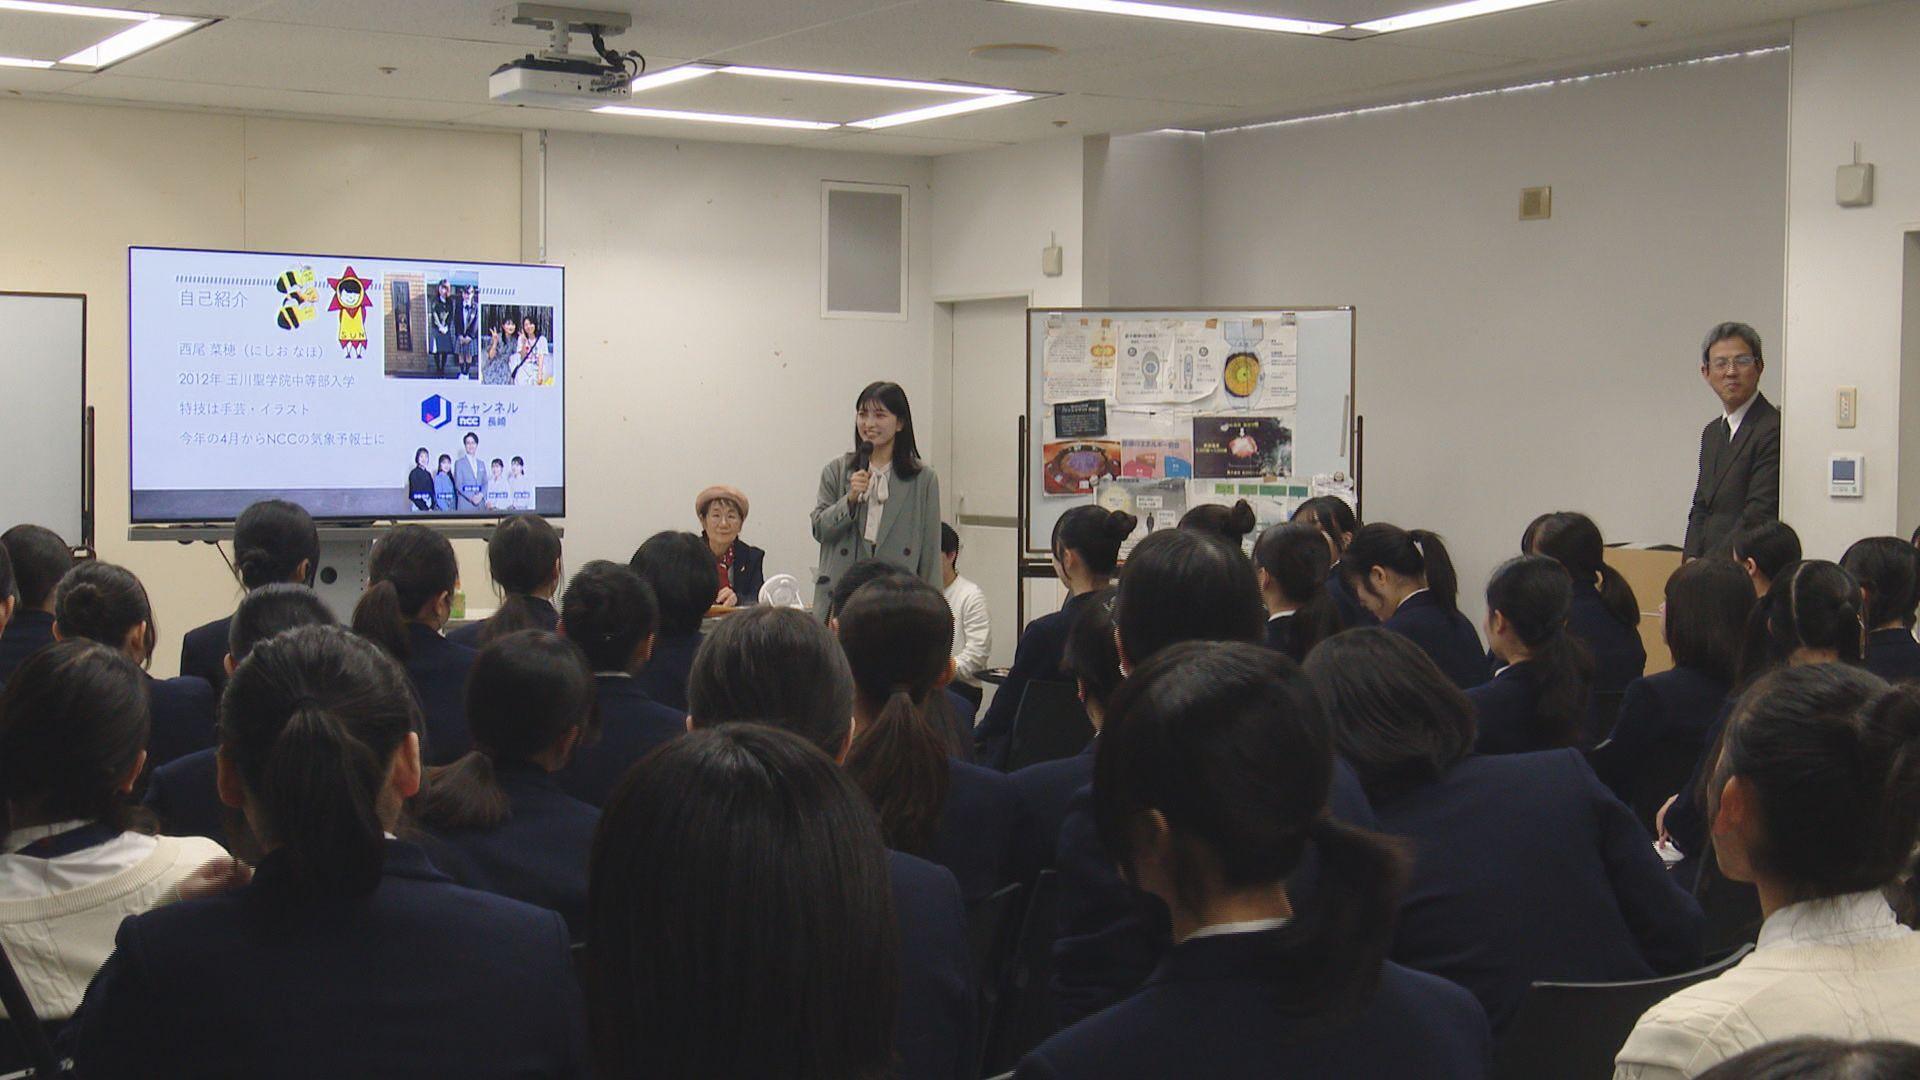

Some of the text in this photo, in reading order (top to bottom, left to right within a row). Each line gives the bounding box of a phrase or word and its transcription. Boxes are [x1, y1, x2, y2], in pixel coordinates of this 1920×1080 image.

[180, 289, 248, 309] 自己紹介
[341, 331, 365, 339] SUN
[179, 343, 206, 357] 西尾
[179, 372, 355, 388] 2012年 玉川聖学院中等部入学
[179, 402, 309, 416] 特技は手芸・イラスト
[457, 401, 519, 414] チャンネル
[179, 431, 385, 446] 今年の4月からNCCの気象予報士に
